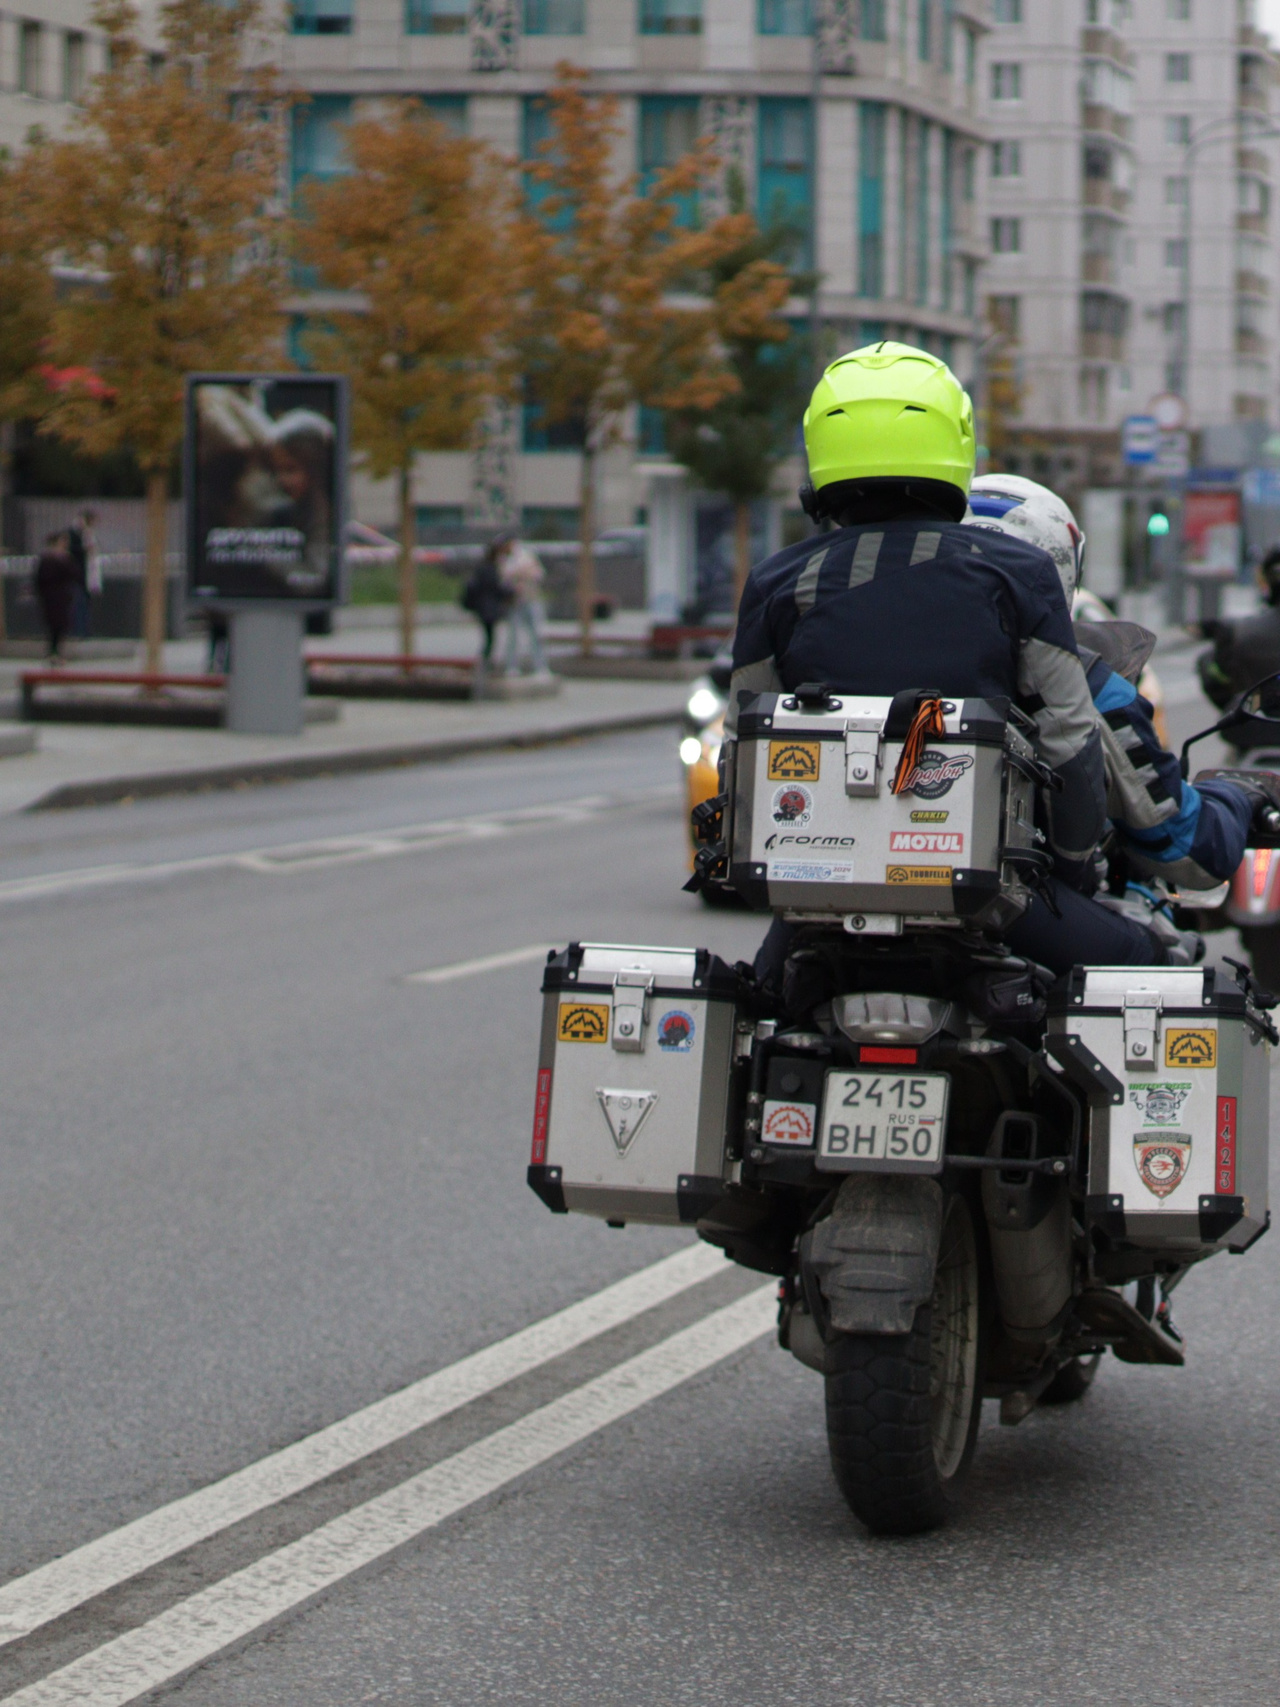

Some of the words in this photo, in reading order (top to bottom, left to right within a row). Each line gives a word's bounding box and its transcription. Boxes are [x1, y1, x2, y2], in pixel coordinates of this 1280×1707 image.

[891, 834, 961, 851] MOTUL
[909, 870, 950, 878] TOURFELLA
[842, 1078, 928, 1109] 2415
[888, 1113, 916, 1125] RUS
[890, 1126, 932, 1157] 50
